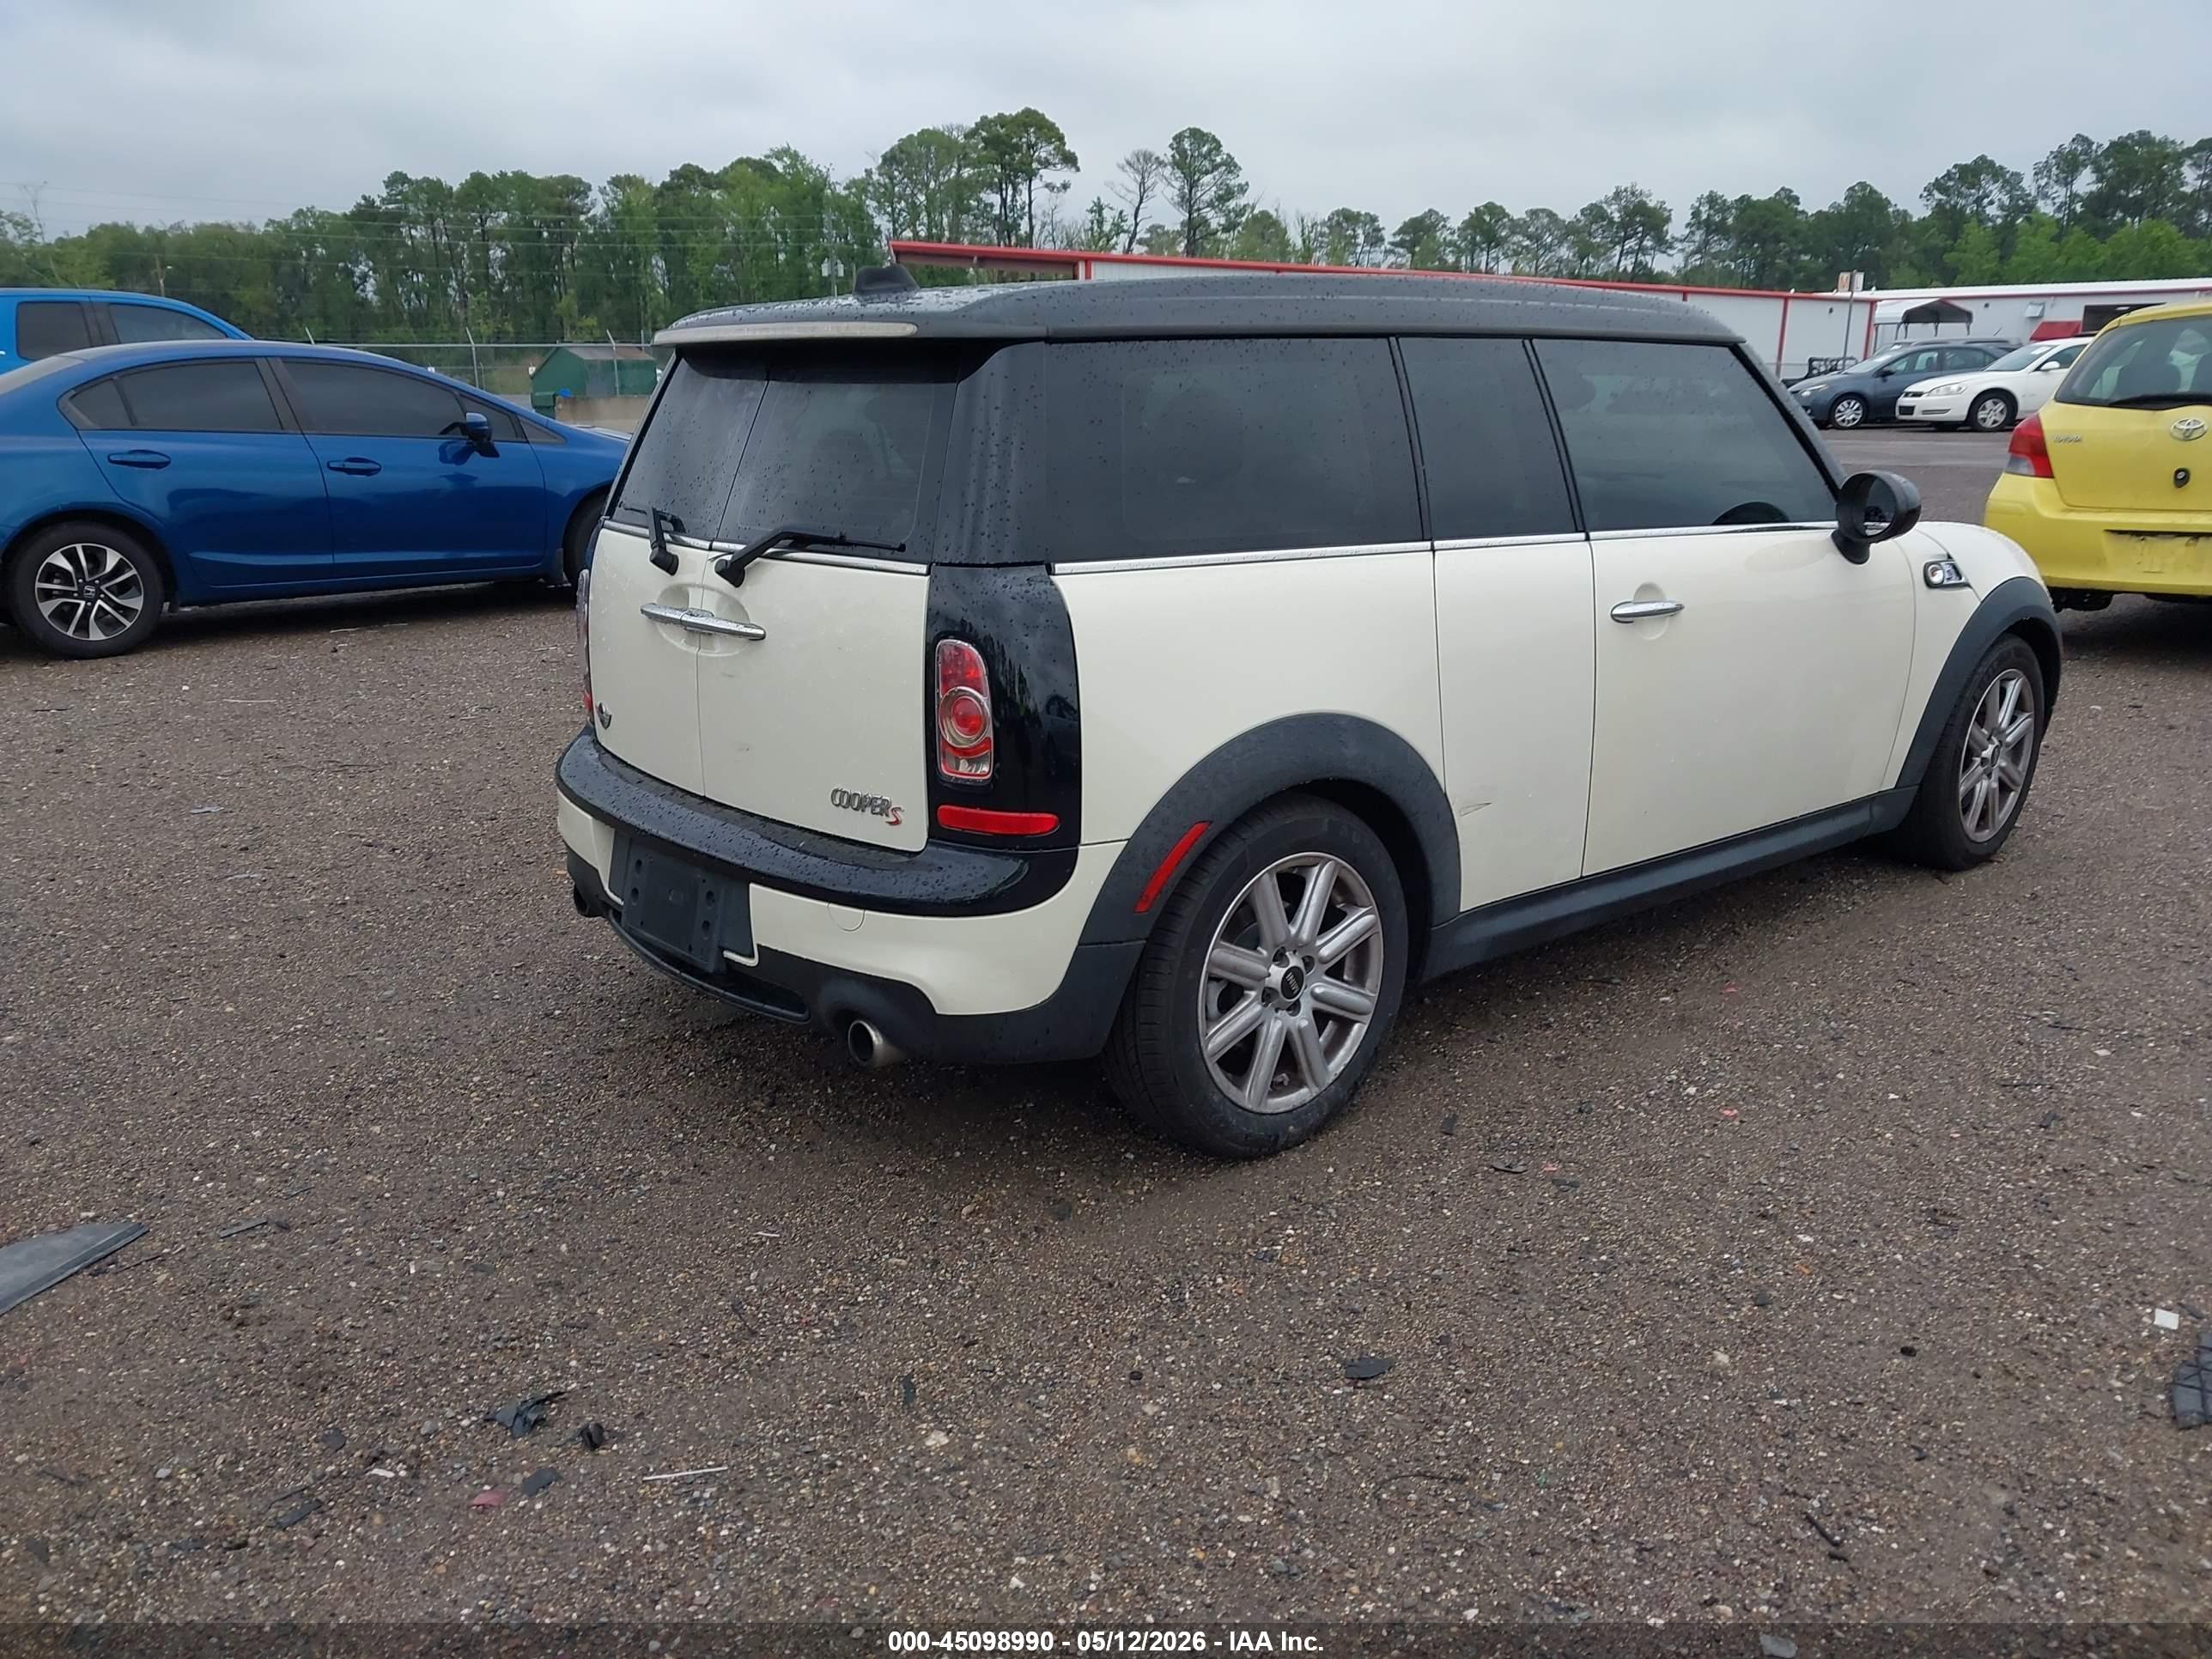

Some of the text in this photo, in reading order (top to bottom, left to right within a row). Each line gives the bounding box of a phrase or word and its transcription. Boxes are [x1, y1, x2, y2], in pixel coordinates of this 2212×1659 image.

[830, 787, 905, 826] COOPER S
[1285, 972, 1300, 995] MINI
